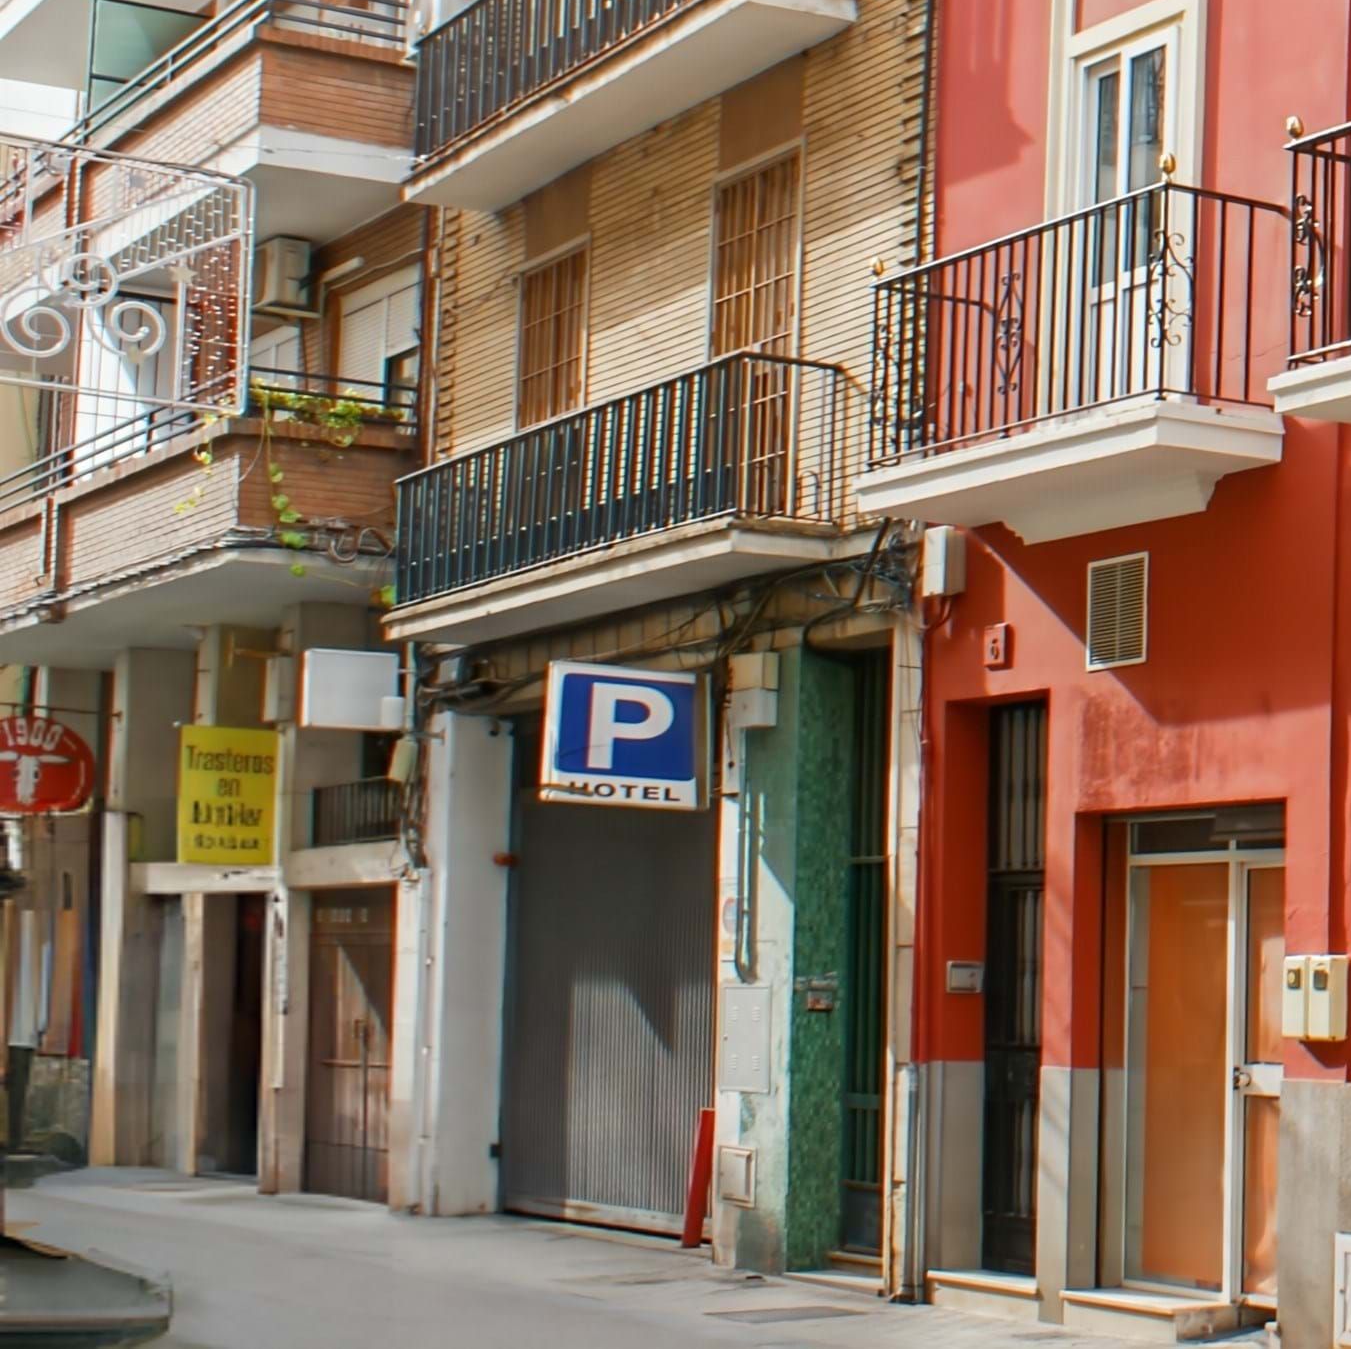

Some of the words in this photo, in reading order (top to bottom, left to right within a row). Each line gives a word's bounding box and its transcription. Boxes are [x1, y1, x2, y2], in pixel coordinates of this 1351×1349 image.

[2, 717, 64, 751] 1900
[587, 682, 675, 770] P
[186, 745, 275, 775] Trasteros
